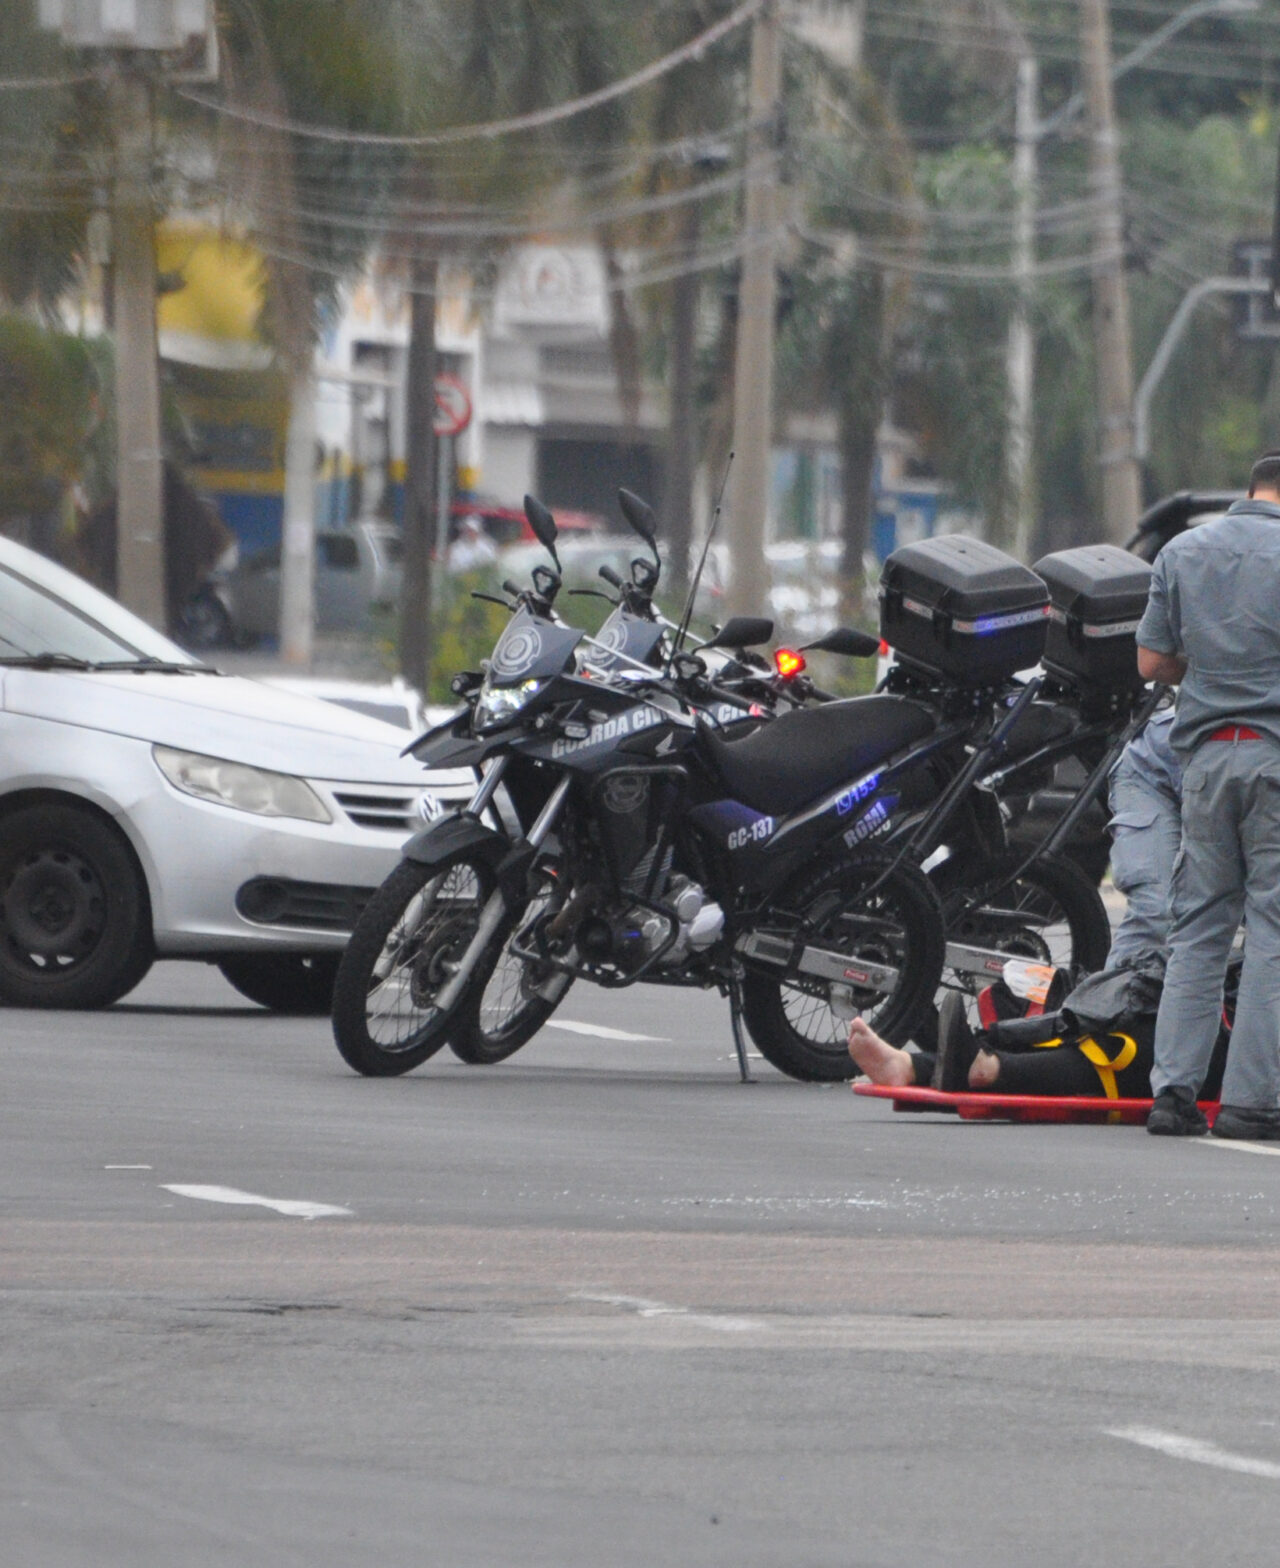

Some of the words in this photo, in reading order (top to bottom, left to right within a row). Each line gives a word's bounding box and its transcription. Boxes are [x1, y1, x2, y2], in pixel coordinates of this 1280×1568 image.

[851, 773, 881, 802] 153
[728, 816, 773, 849] GC-137
[843, 802, 888, 849] ROMI
